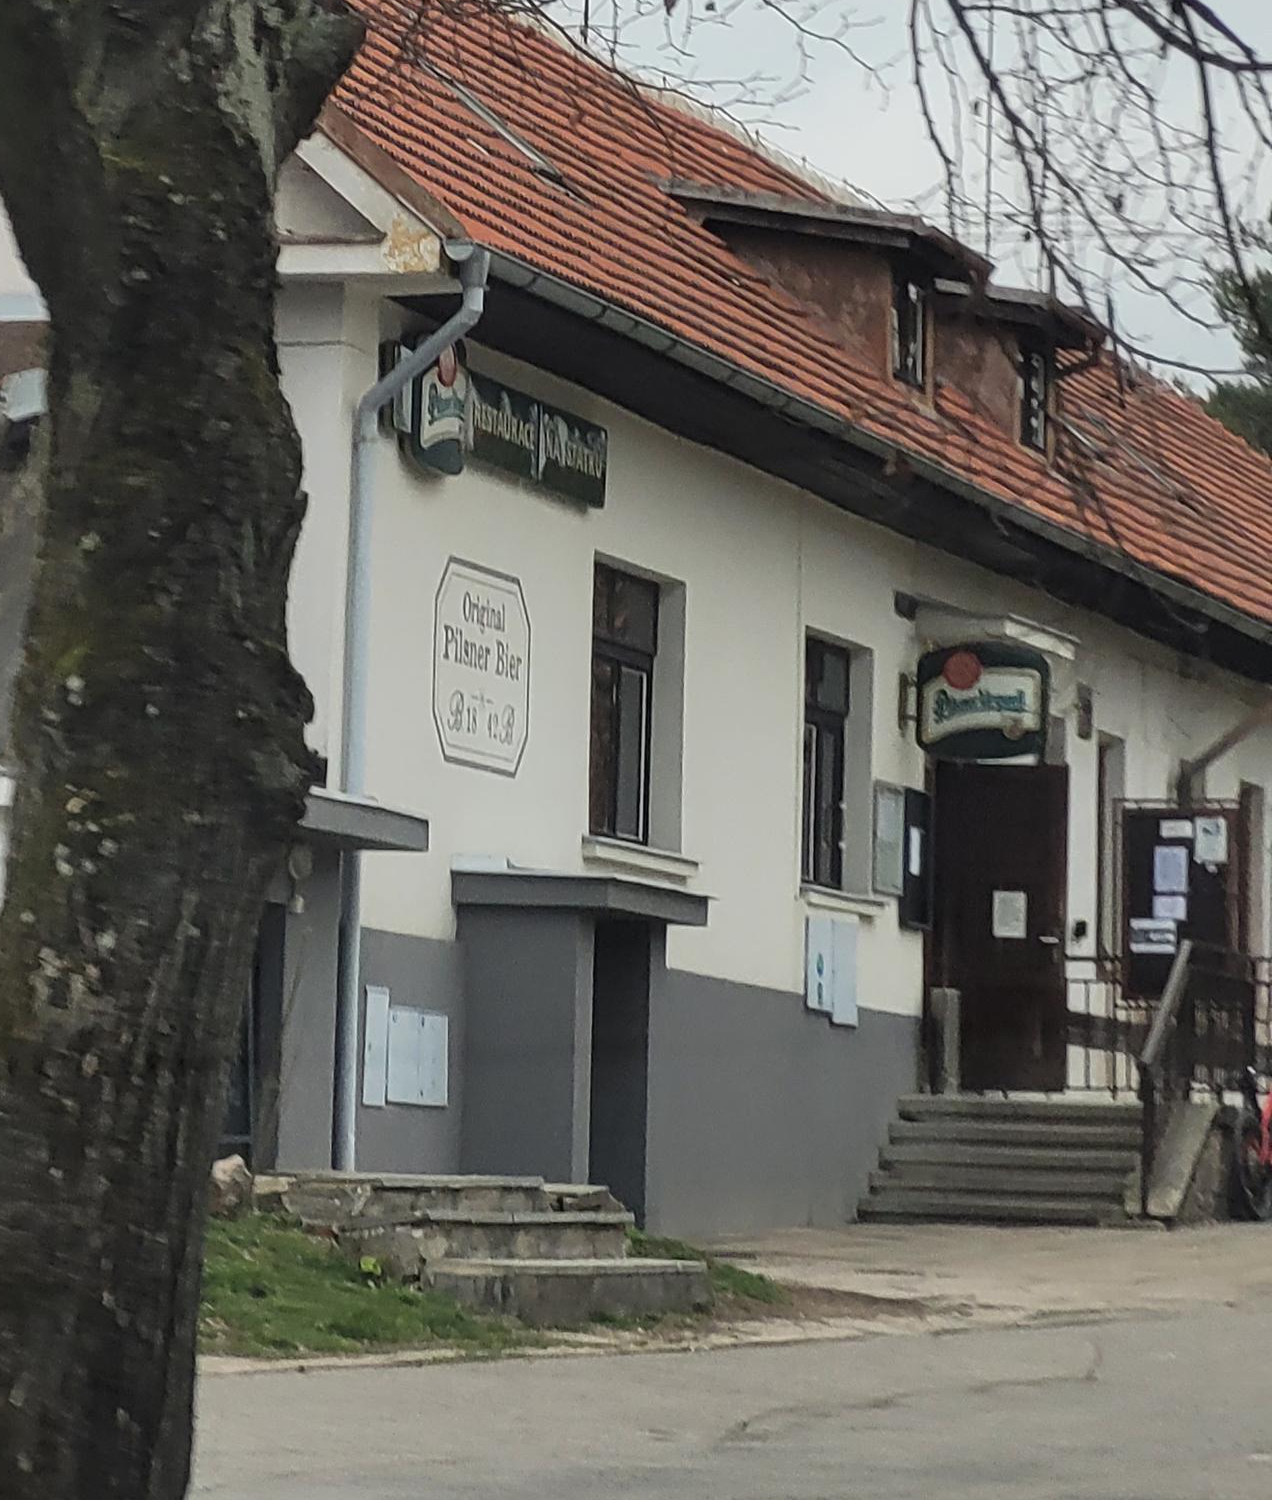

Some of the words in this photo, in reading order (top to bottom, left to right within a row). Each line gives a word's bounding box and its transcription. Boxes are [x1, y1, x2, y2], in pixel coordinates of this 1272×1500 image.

[462, 590, 506, 634] Original
[442, 624, 491, 672] Pilsner
[495, 638, 523, 681] Bier
